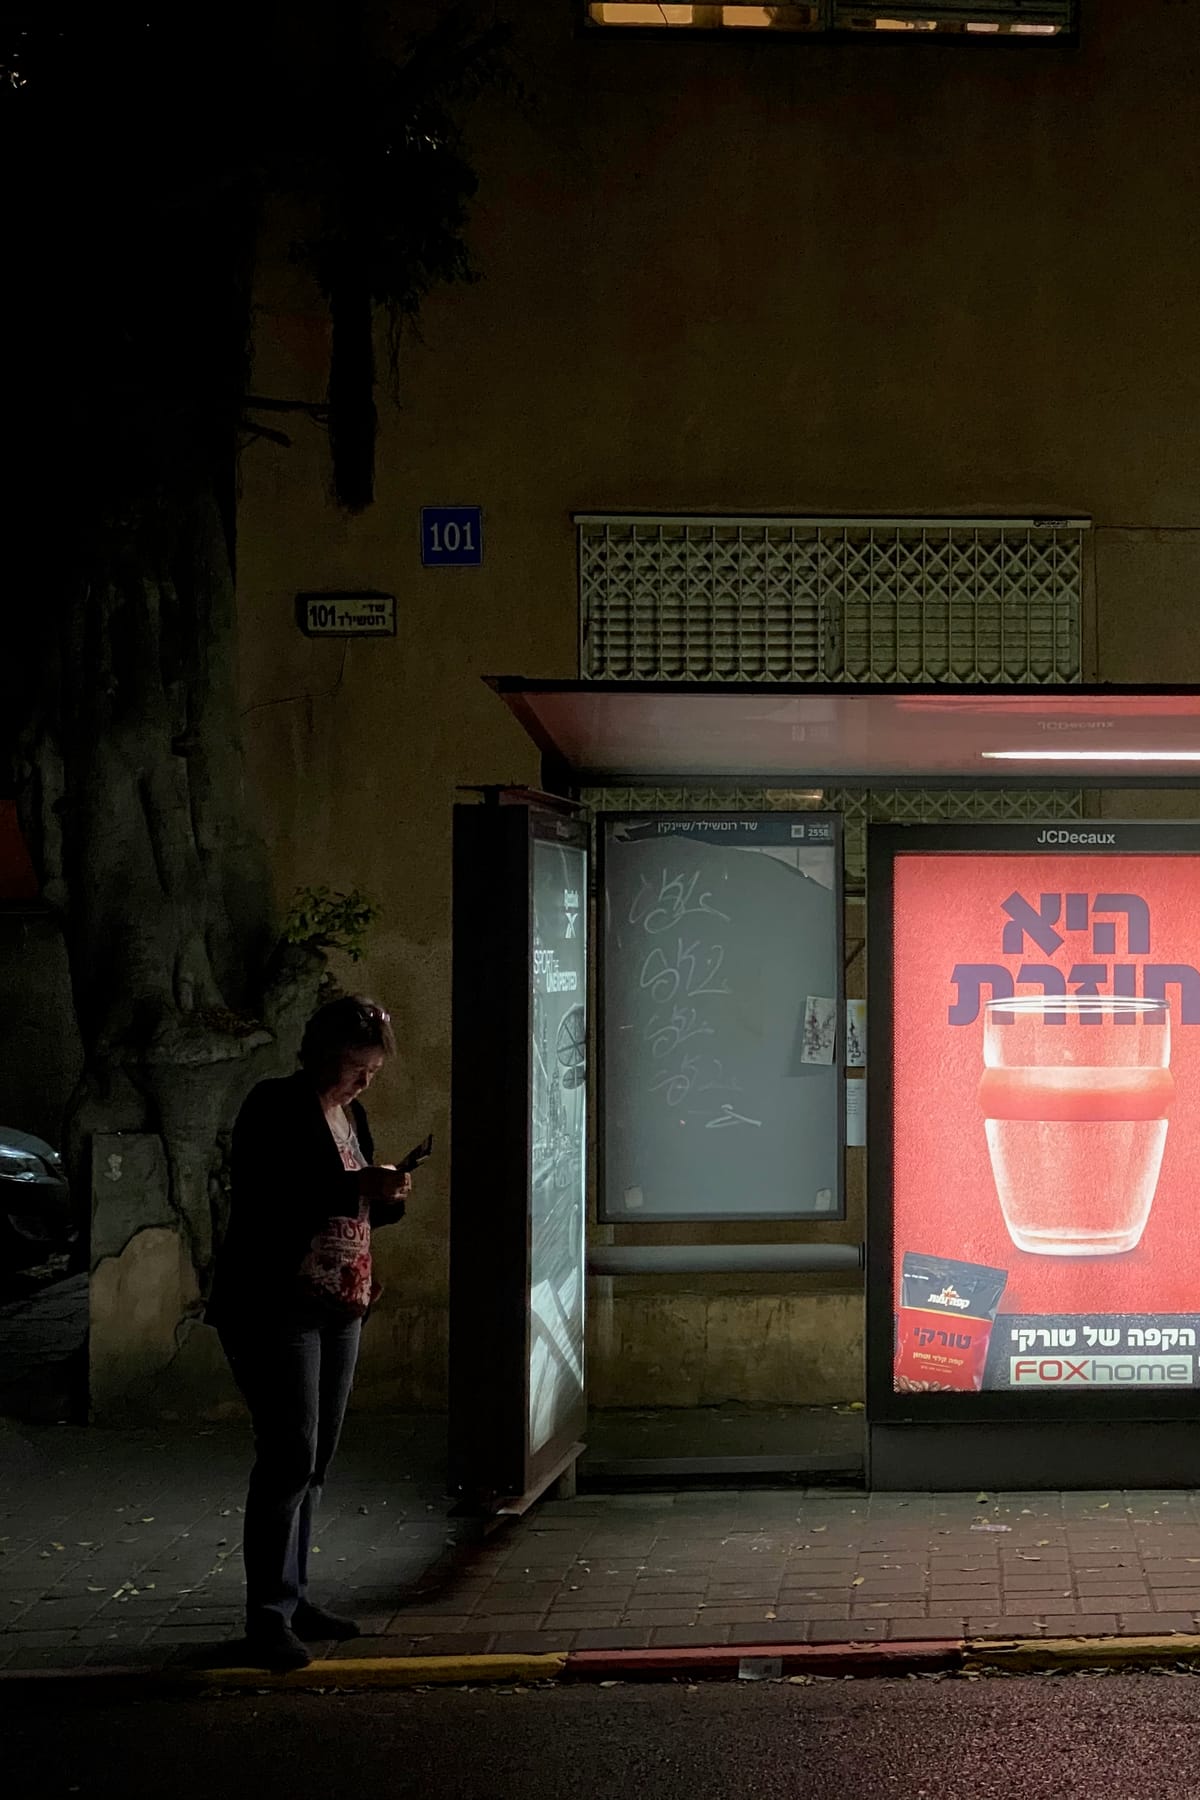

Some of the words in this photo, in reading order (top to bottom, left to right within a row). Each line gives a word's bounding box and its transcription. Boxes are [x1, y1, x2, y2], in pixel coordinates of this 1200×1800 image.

[430, 522, 475, 551] 101
[310, 605, 337, 627] 101
[1037, 830, 1115, 844] JCDecaux
[1000, 890, 1150, 957] היא
[913, 1327, 972, 1350] טורקי
[1011, 1327, 1077, 1352] טורקי
[1083, 1326, 1121, 1347] של
[1127, 1327, 1196, 1351] הקפה
[1015, 1359, 1188, 1382] FOXhome
